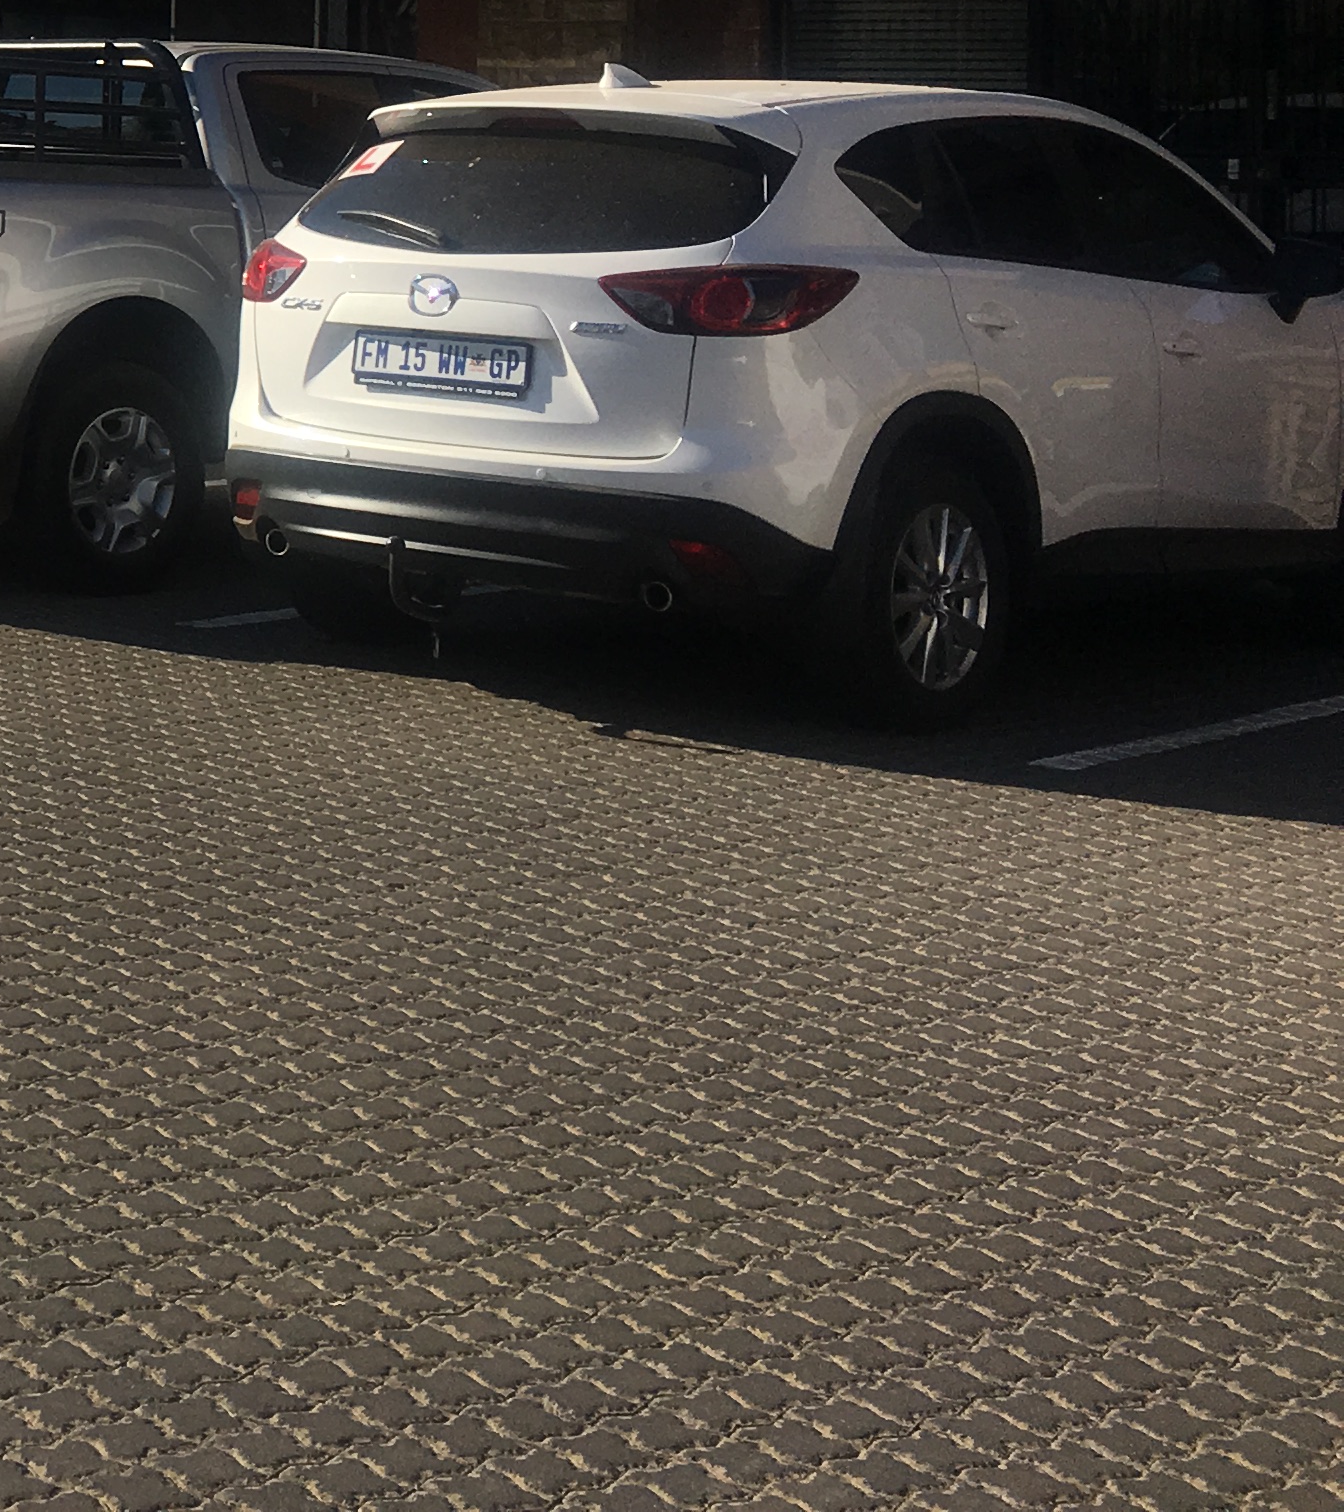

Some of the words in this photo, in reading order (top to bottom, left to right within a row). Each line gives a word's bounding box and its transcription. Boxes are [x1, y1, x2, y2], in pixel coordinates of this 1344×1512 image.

[361, 338, 390, 369] FM
[399, 341, 427, 372] 15
[438, 344, 468, 376] WW
[489, 348, 520, 380] GP
